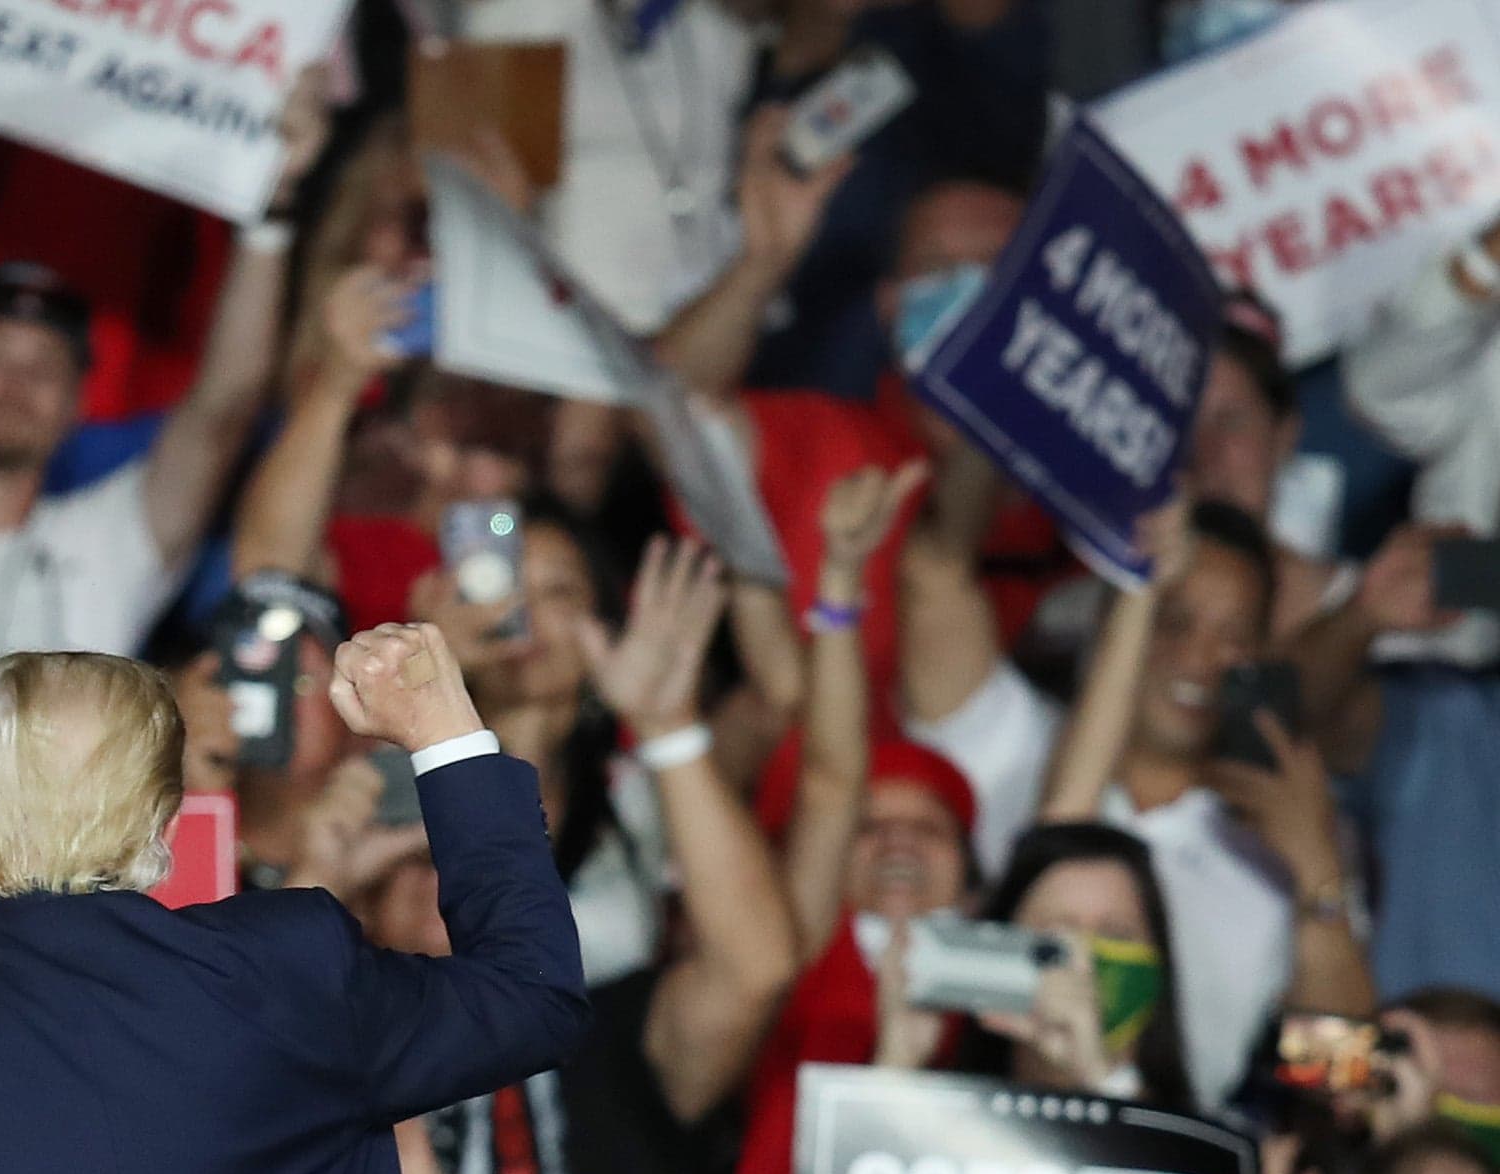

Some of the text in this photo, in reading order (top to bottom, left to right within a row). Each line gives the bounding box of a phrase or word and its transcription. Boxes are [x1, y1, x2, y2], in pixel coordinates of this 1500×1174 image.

[1177, 43, 1479, 212] 4 MORE
[1043, 225, 1095, 291] 4
